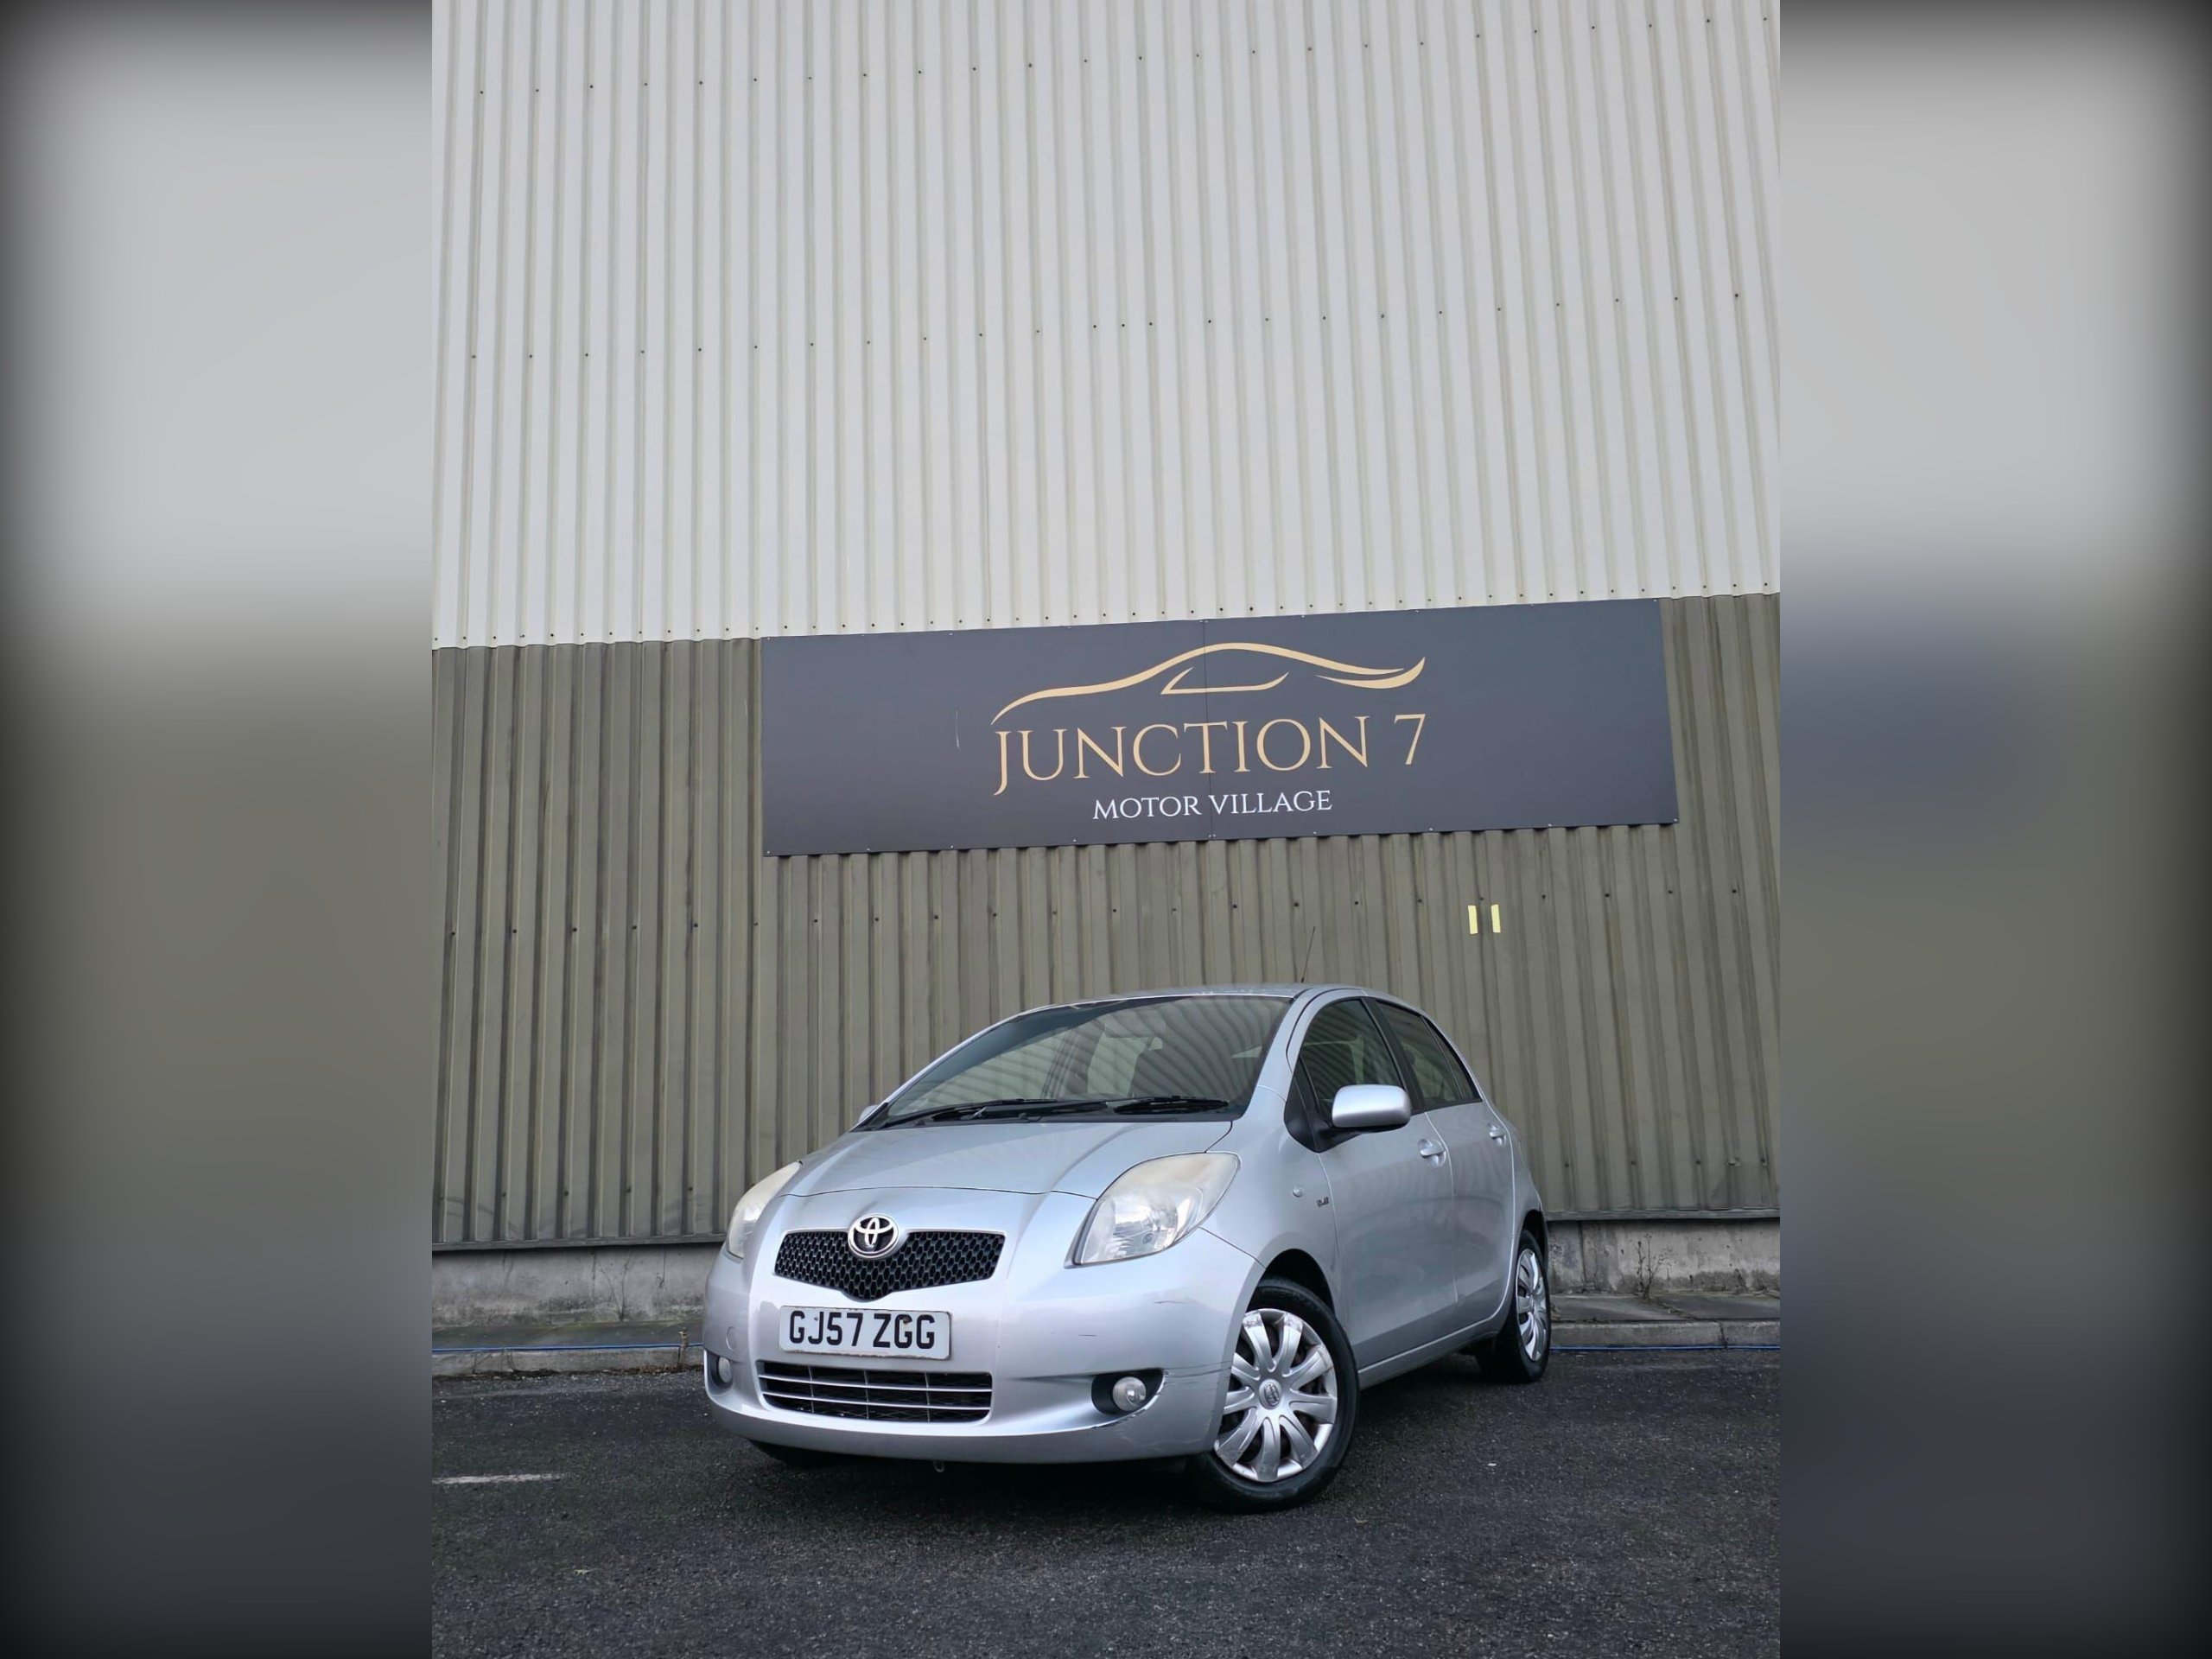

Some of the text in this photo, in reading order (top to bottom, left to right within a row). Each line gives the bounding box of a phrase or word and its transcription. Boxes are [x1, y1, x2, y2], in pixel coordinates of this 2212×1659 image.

[994, 714, 1426, 796] JUNCTION 7
[1092, 790, 1332, 820] MOTOR VILLAGE
[789, 1310, 935, 1350] GJ57 ZGG
